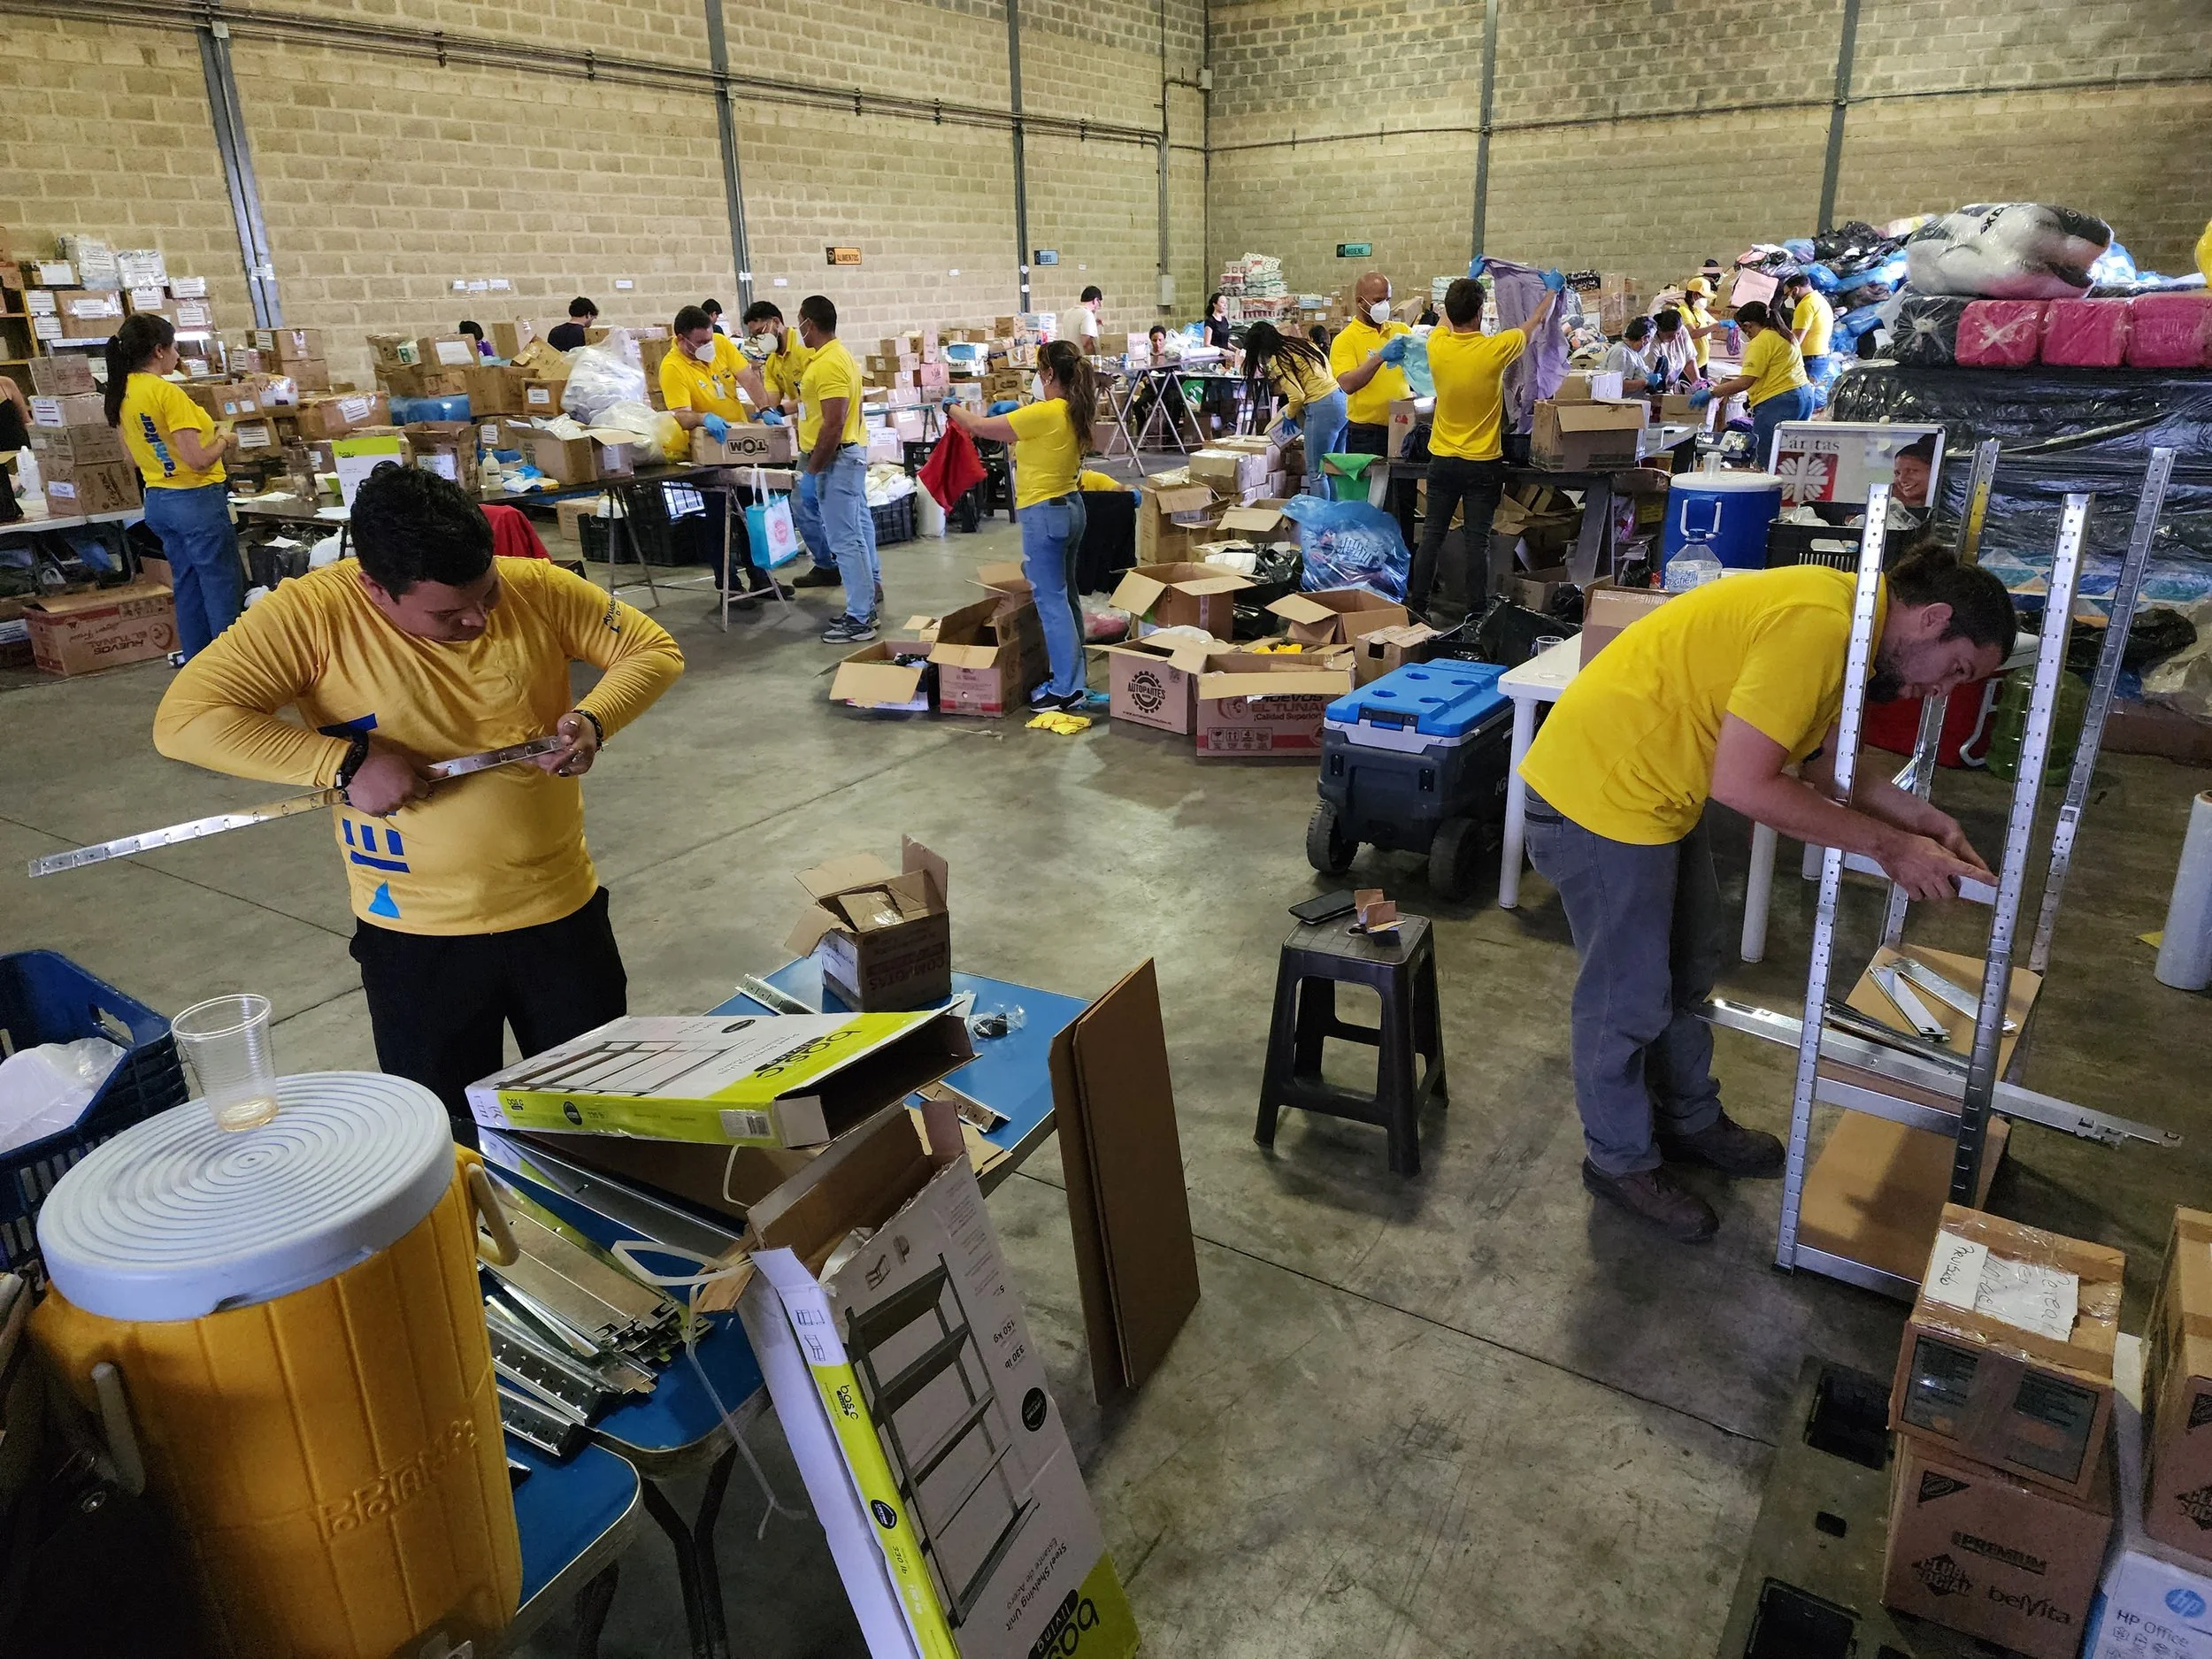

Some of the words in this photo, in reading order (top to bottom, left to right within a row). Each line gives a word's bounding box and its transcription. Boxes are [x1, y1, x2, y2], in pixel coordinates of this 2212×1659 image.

[729, 439, 766, 454] TOM
[1780, 434, 1840, 451] Cártas
[94, 640, 143, 656] HUEVOS
[1127, 681, 1166, 700] AUTOPARTES
[1003, 1319, 1016, 1335] 150
[994, 1333, 1003, 1344] kg
[1012, 1345, 1025, 1363] 330
[892, 1545, 904, 1563] 330
[1034, 1538, 1058, 1570] Estante
[1049, 1542, 1067, 1570] Steel
[1007, 1584, 1025, 1609] Acero
[1020, 1566, 1050, 1608] Shelving
[1986, 1585, 2071, 1624] belVita
[2170, 1590, 2204, 1617] hp
[1005, 1608, 1022, 1631] Unit
[2116, 1609, 2140, 1625] HP
[1037, 1602, 1071, 1653] living
